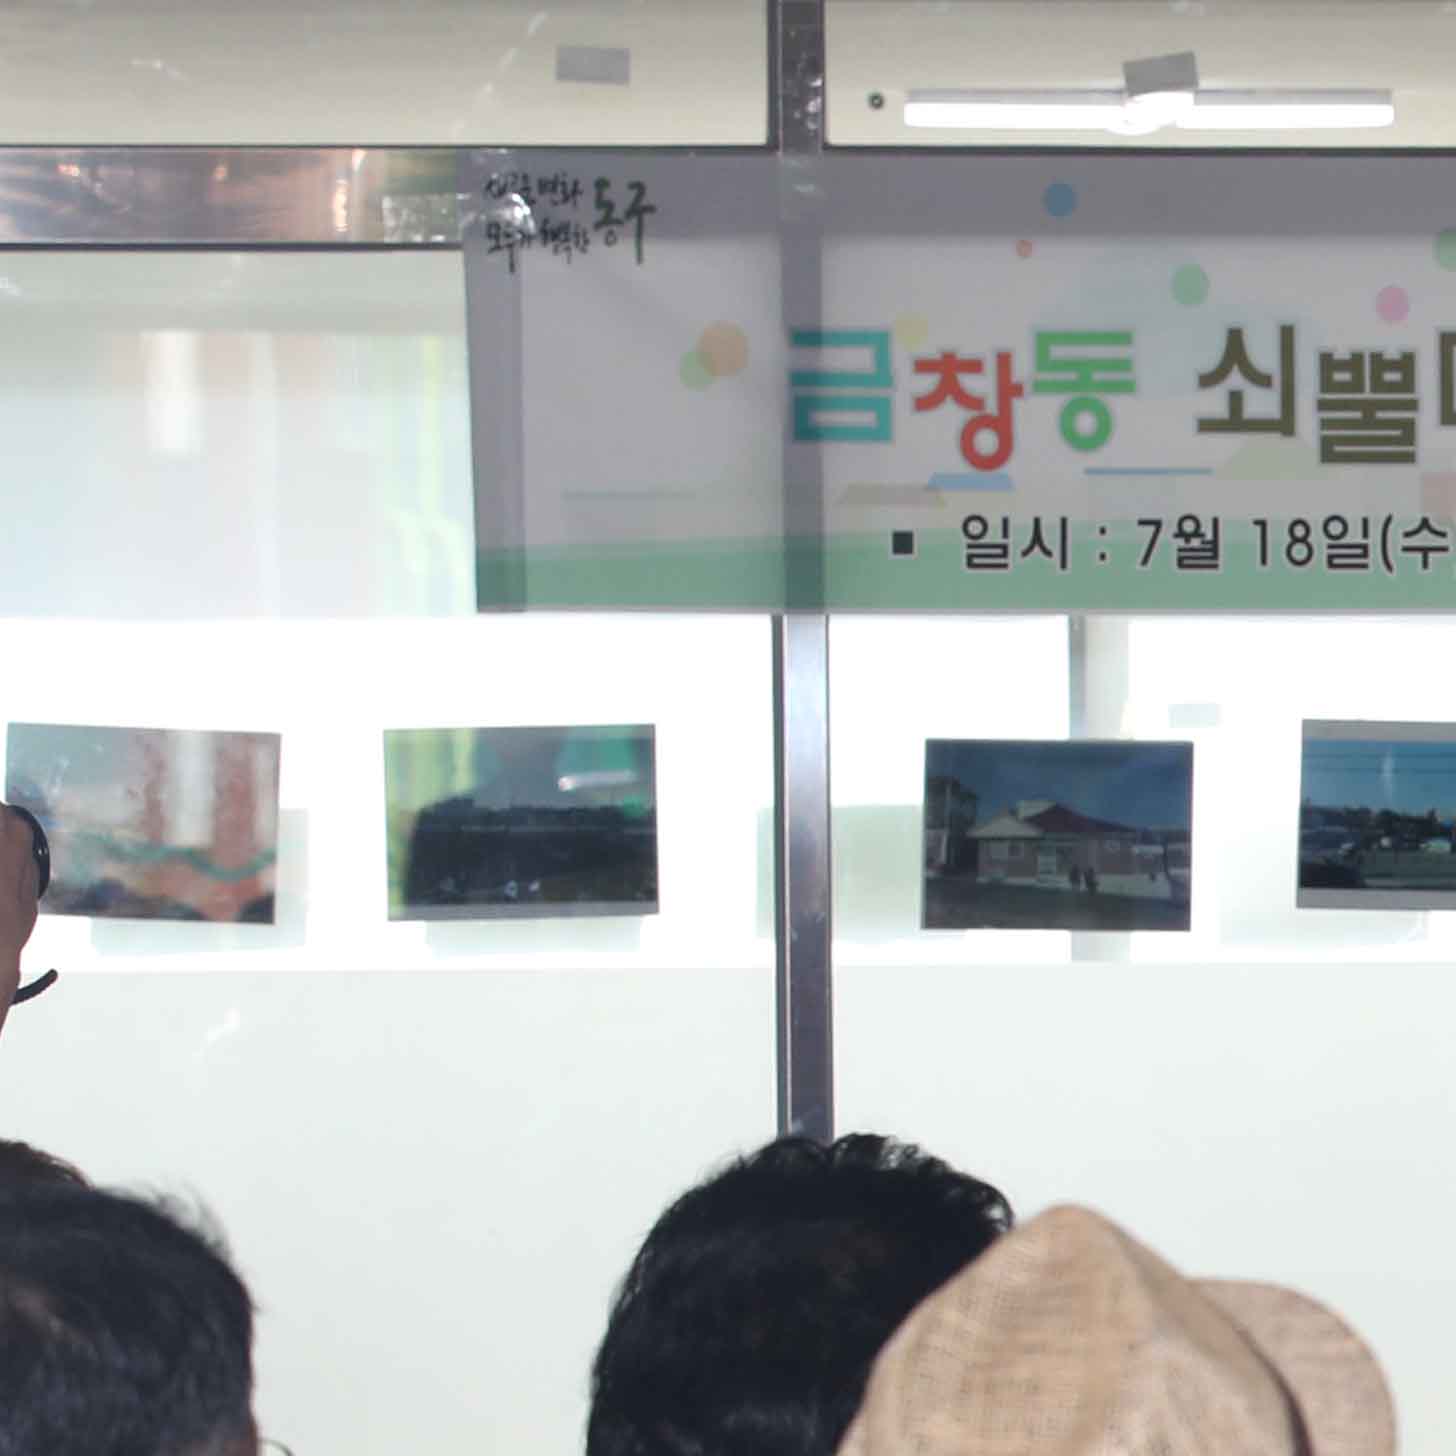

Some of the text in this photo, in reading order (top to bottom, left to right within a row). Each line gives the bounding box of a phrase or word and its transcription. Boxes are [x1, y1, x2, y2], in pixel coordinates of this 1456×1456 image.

[592, 177, 656, 265] 동구
[789, 328, 1138, 472] 금창동
[960, 514, 1070, 571] 일시
[1137, 514, 1222, 571] 7월
